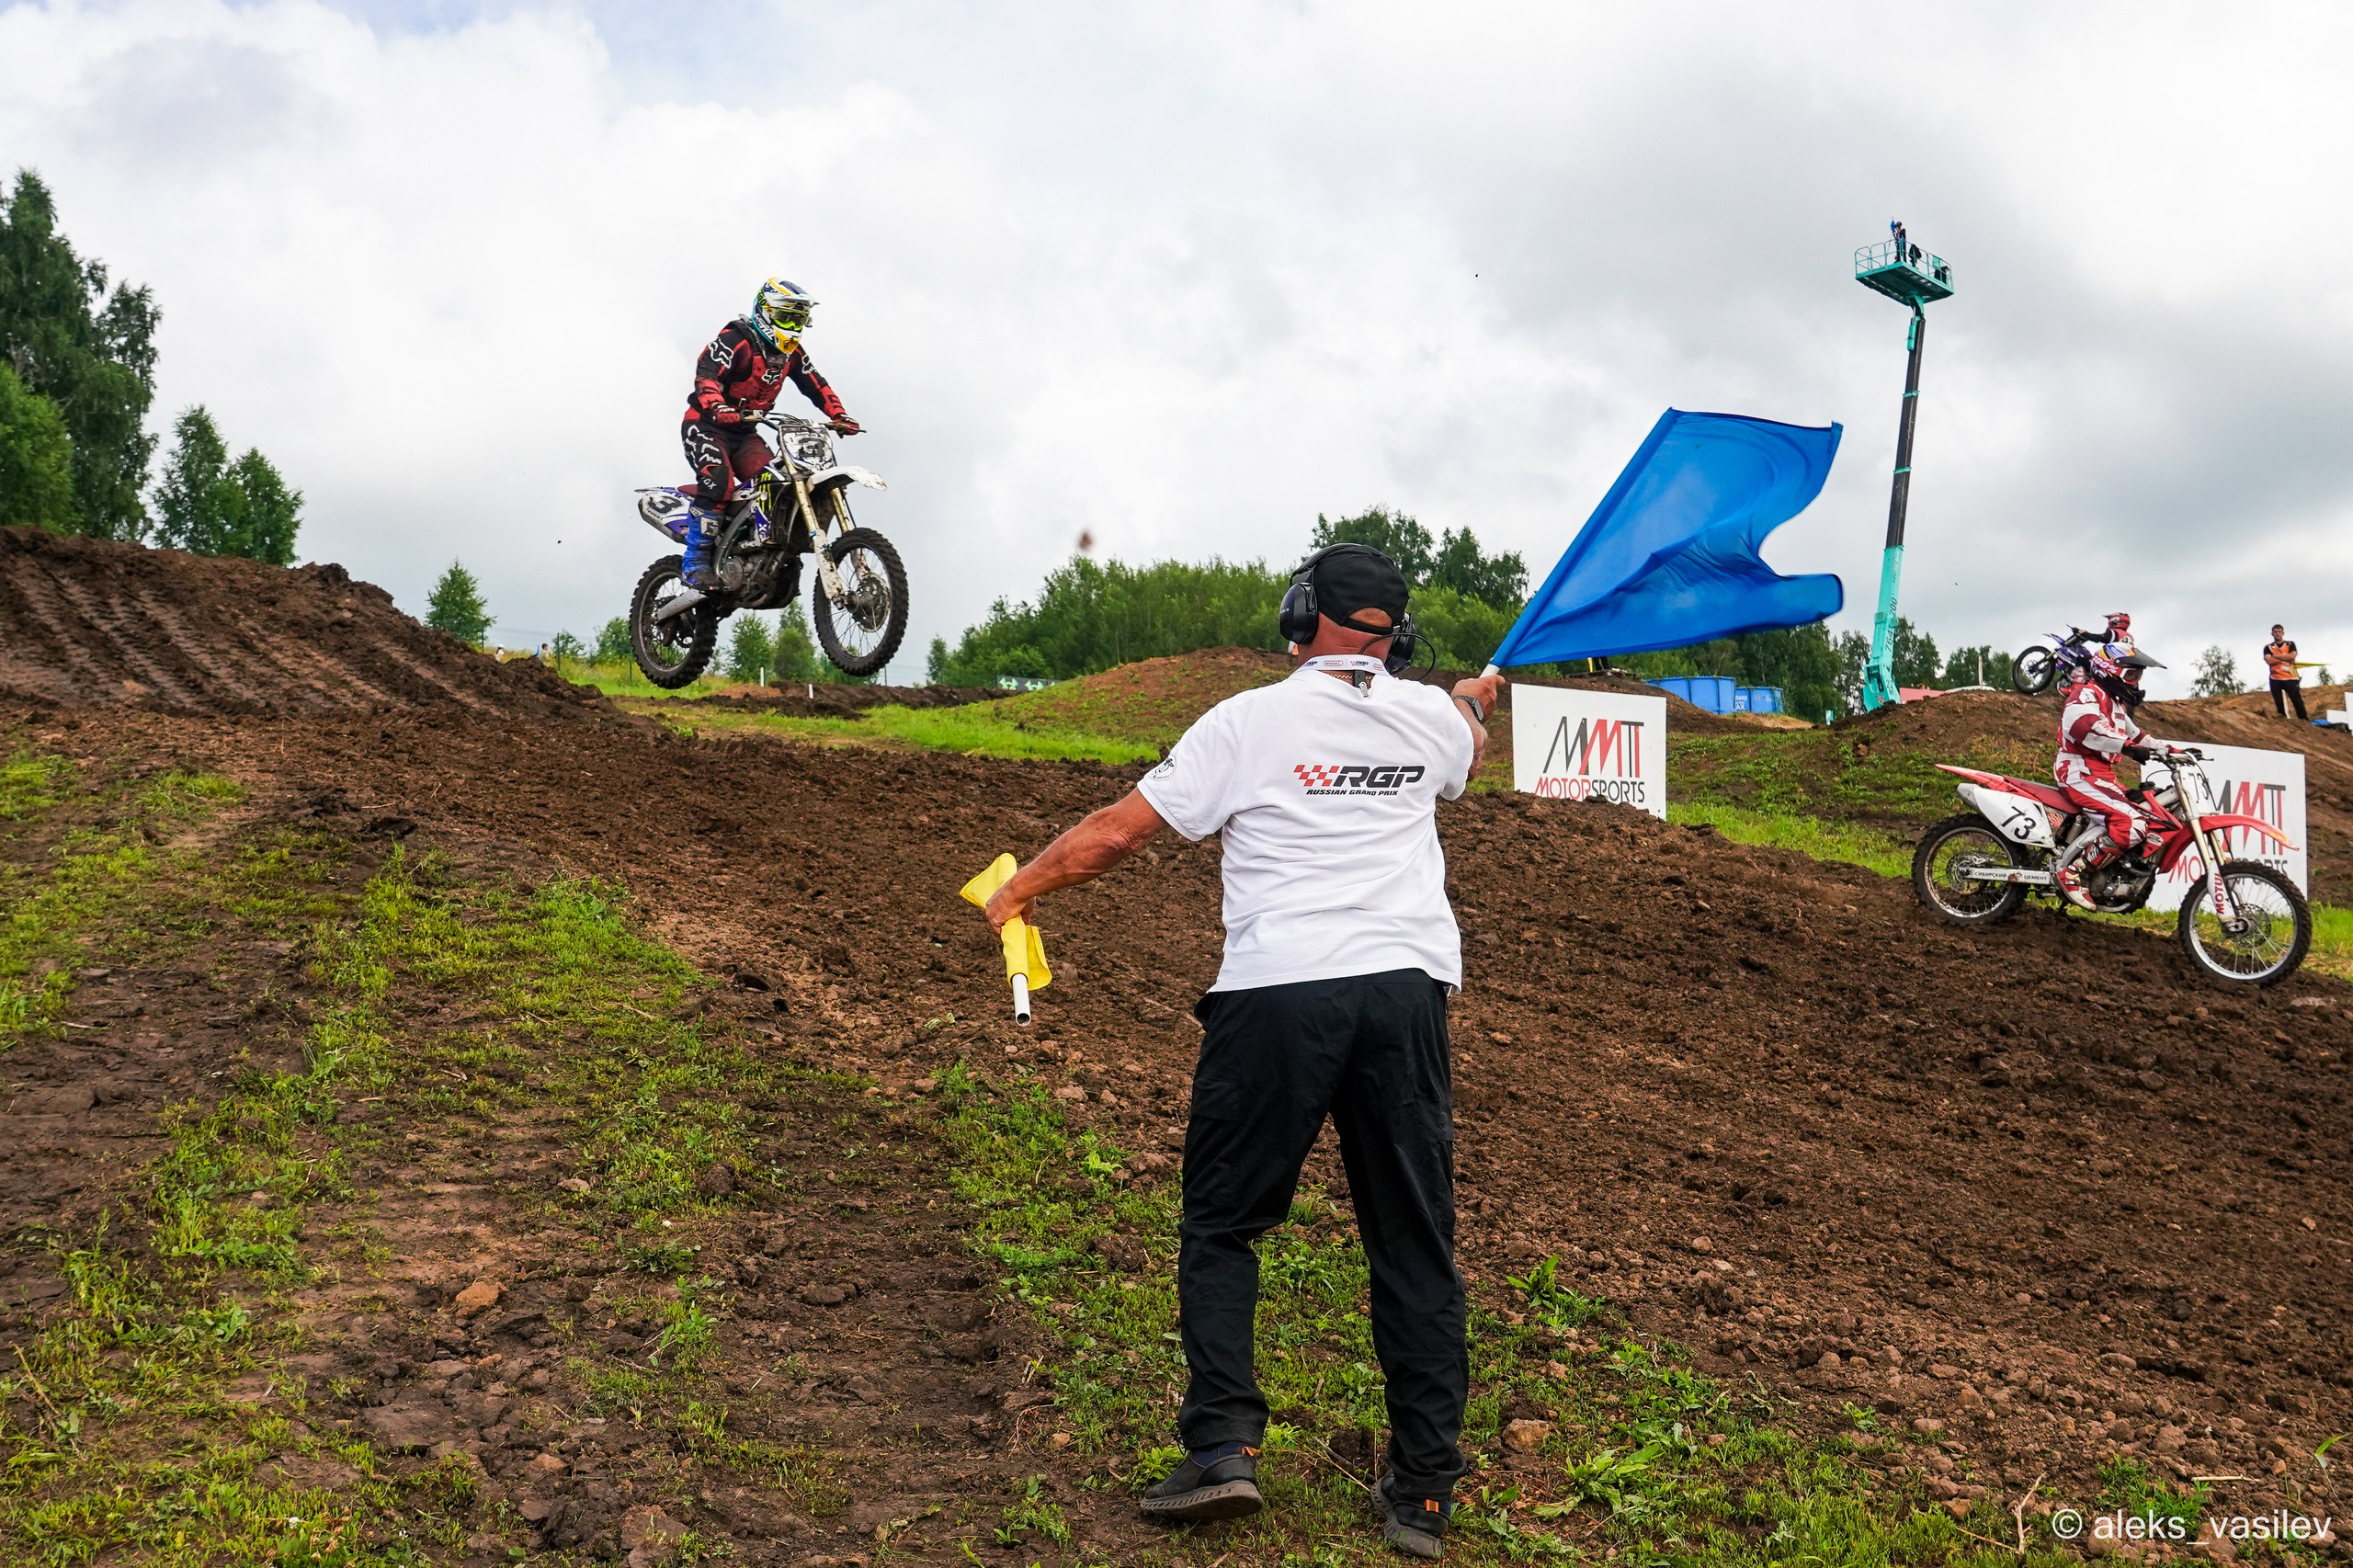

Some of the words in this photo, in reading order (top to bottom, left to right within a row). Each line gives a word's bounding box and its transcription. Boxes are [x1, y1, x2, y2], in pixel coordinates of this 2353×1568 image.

[647, 495, 684, 515] 3
[1542, 716, 1644, 778] MMT
[1333, 766, 1426, 788] RGP
[1534, 777, 1645, 803] MOTORSPORTS
[2000, 805, 2037, 840] 73
[2214, 872, 2225, 915] MOTUL
